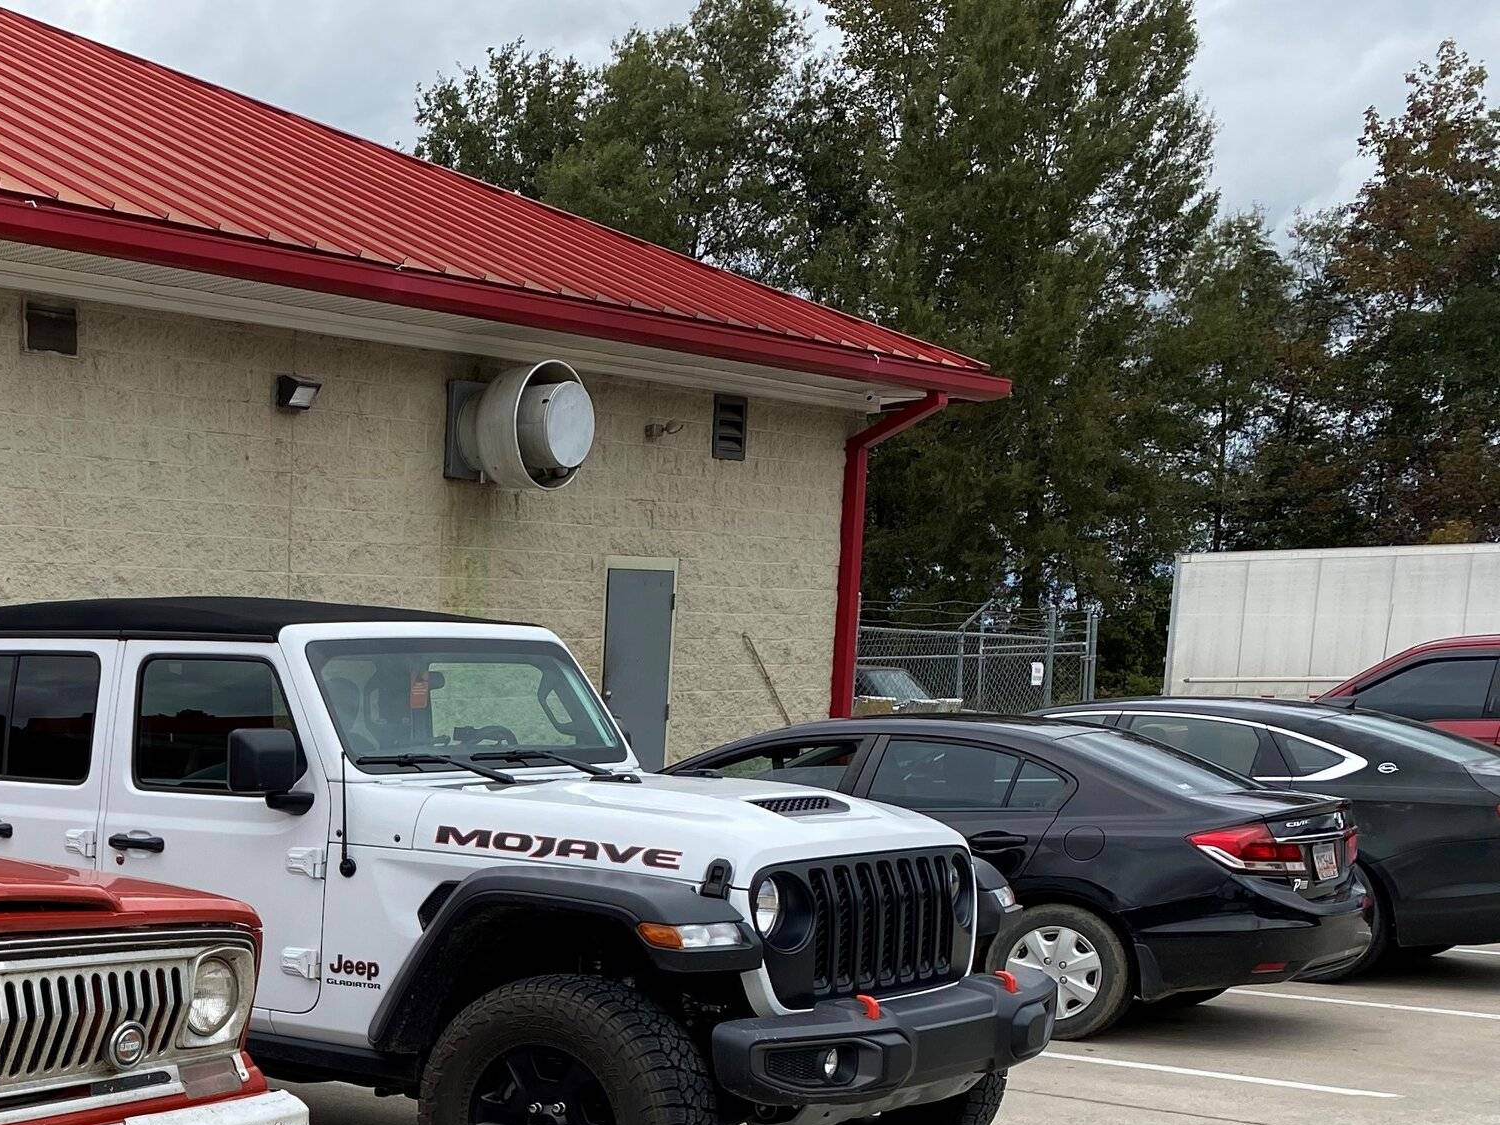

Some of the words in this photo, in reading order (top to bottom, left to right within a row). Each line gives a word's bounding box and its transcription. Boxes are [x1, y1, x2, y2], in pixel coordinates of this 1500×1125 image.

[1285, 818, 1311, 828] CIVIC
[434, 825, 683, 870] MOJAVE
[329, 954, 380, 981] Jeep
[326, 977, 381, 990] GLADIATOR
